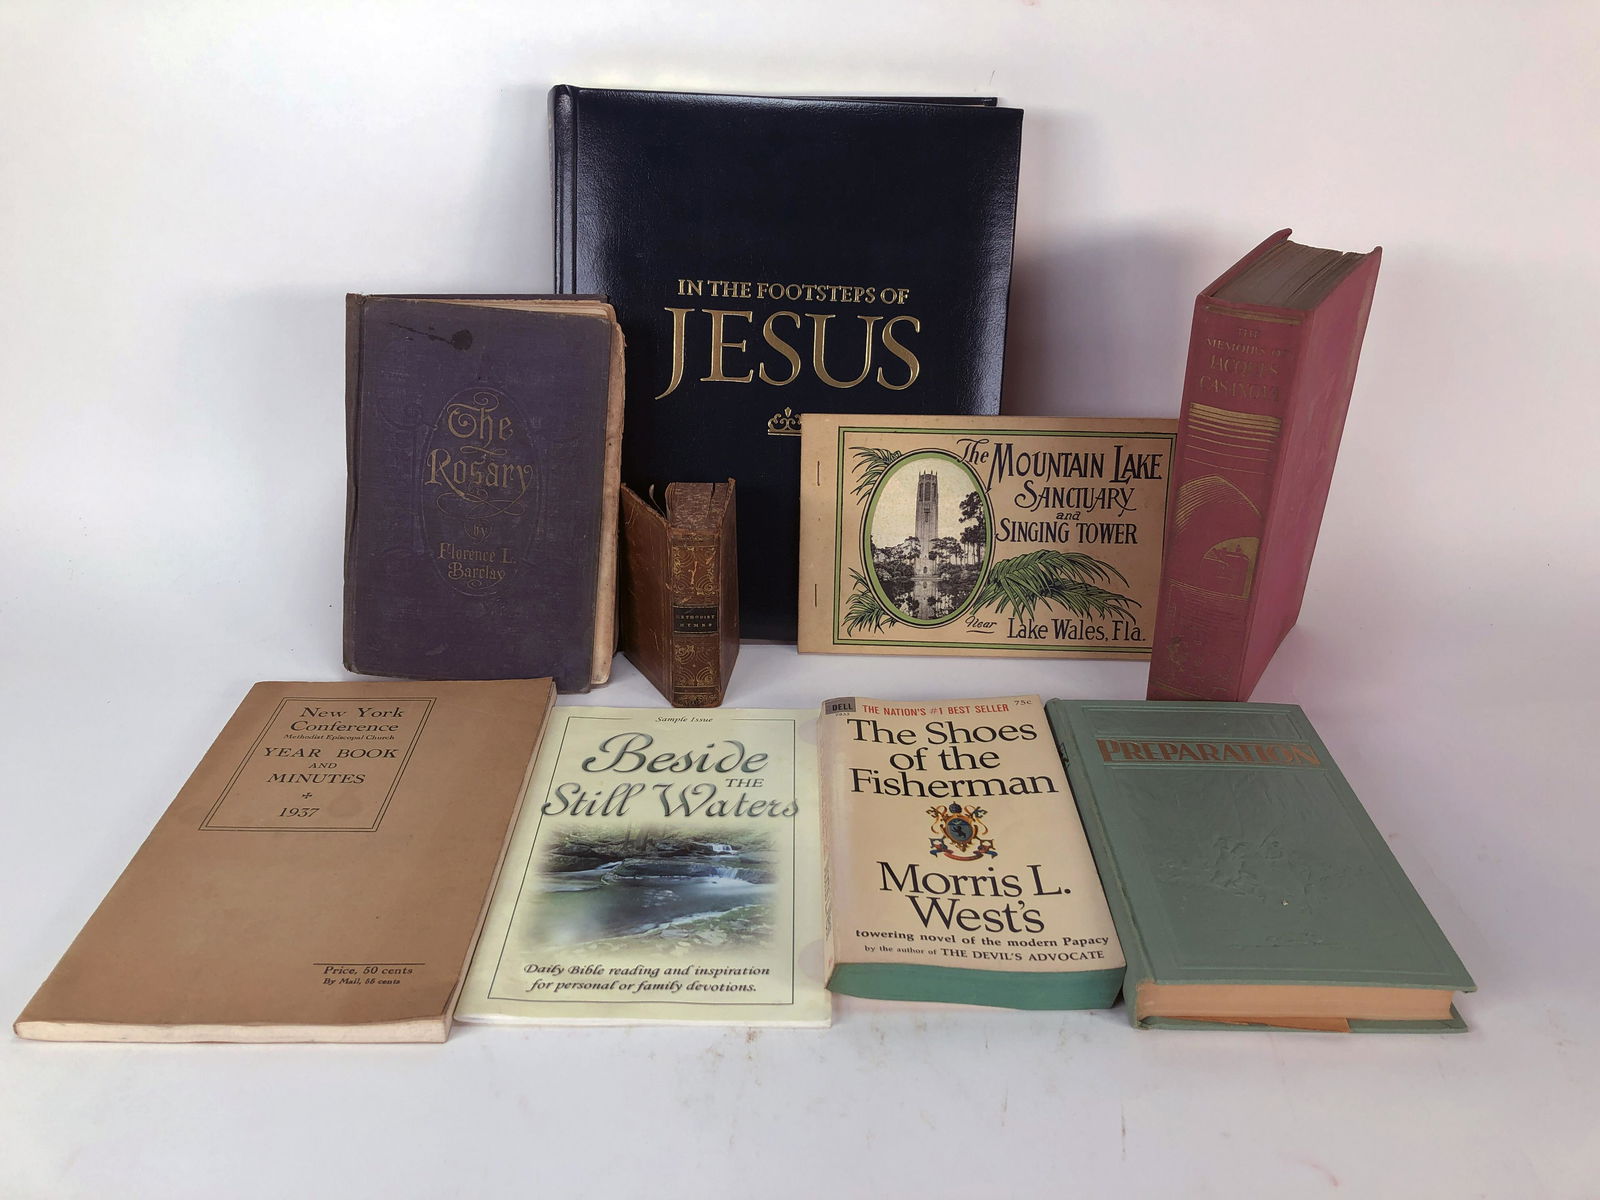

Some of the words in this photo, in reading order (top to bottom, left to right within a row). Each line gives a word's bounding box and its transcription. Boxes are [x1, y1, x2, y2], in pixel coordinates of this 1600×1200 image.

[677, 279, 702, 296] IN
[708, 280, 751, 298] THE
[757, 282, 876, 304] FOOTSTEPS
[880, 288, 910, 305] OF
[655, 306, 920, 400] JESUS
[1210, 355, 1280, 377] JACQES
[447, 392, 514, 453] The
[424, 448, 534, 506] Rosary
[956, 438, 990, 465] The
[986, 442, 1105, 494] MOUNTAIN
[1109, 445, 1164, 485] LAKE
[1014, 480, 1137, 517] SANCTUARY
[1056, 511, 1081, 521] and
[994, 517, 1070, 544] SINGING
[1075, 521, 1139, 545] TOWER
[437, 542, 496, 563] Florence
[501, 548, 518, 564] L.
[448, 561, 506, 581] Barclay
[965, 616, 998, 629] Near
[1007, 617, 1049, 640] Lake
[1051, 618, 1109, 642] Wales,
[1111, 620, 1147, 642] Fla.
[299, 706, 347, 718] New
[357, 707, 405, 718] York
[832, 703, 854, 711] DELL
[862, 704, 880, 714] THE
[883, 707, 927, 717] NATION'S
[930, 707, 943, 715] #1
[947, 706, 973, 715] BEST
[974, 703, 1009, 714] SELLER
[290, 720, 400, 732] Conference
[846, 718, 917, 746] The
[925, 721, 1038, 745] Shoes
[264, 747, 322, 758] YEAR
[336, 748, 399, 758] BOOK
[581, 732, 769, 773] Beside
[889, 747, 928, 771] of
[938, 745, 1001, 771] the
[1096, 738, 1321, 766] PREPARATION
[266, 773, 366, 784] MINUTES
[725, 778, 765, 788] THE
[849, 767, 1059, 798] Fisherman
[540, 782, 646, 817] Still
[652, 783, 799, 817] Waters
[279, 807, 320, 818] 1937
[876, 860, 1023, 898] Morris
[1026, 864, 1072, 896] L.
[904, 894, 1045, 933] West's
[855, 929, 915, 942] towering
[920, 933, 956, 944] novel
[962, 936, 976, 945] of
[981, 936, 1002, 947] the
[1007, 937, 1058, 947] modern
[1063, 936, 1110, 948] Papacy
[864, 944, 876, 952] by
[896, 946, 925, 955] author
[927, 948, 938, 956] of
[940, 947, 968, 958] THE
[972, 951, 1023, 962] DEVIL'S
[1028, 950, 1105, 962] ADVOCATE
[323, 966, 358, 975] Price,
[363, 966, 379, 975] 50
[381, 967, 414, 975] cents
[523, 963, 565, 975] Daily
[567, 964, 605, 975] Bible
[608, 965, 660, 978] reading
[663, 965, 693, 976] and
[694, 966, 770, 978] inspiration
[526, 978, 555, 992] for
[553, 980, 617, 992] personal
[618, 983, 633, 991] or
[633, 980, 682, 993] family
[686, 982, 757, 993] devotions.
